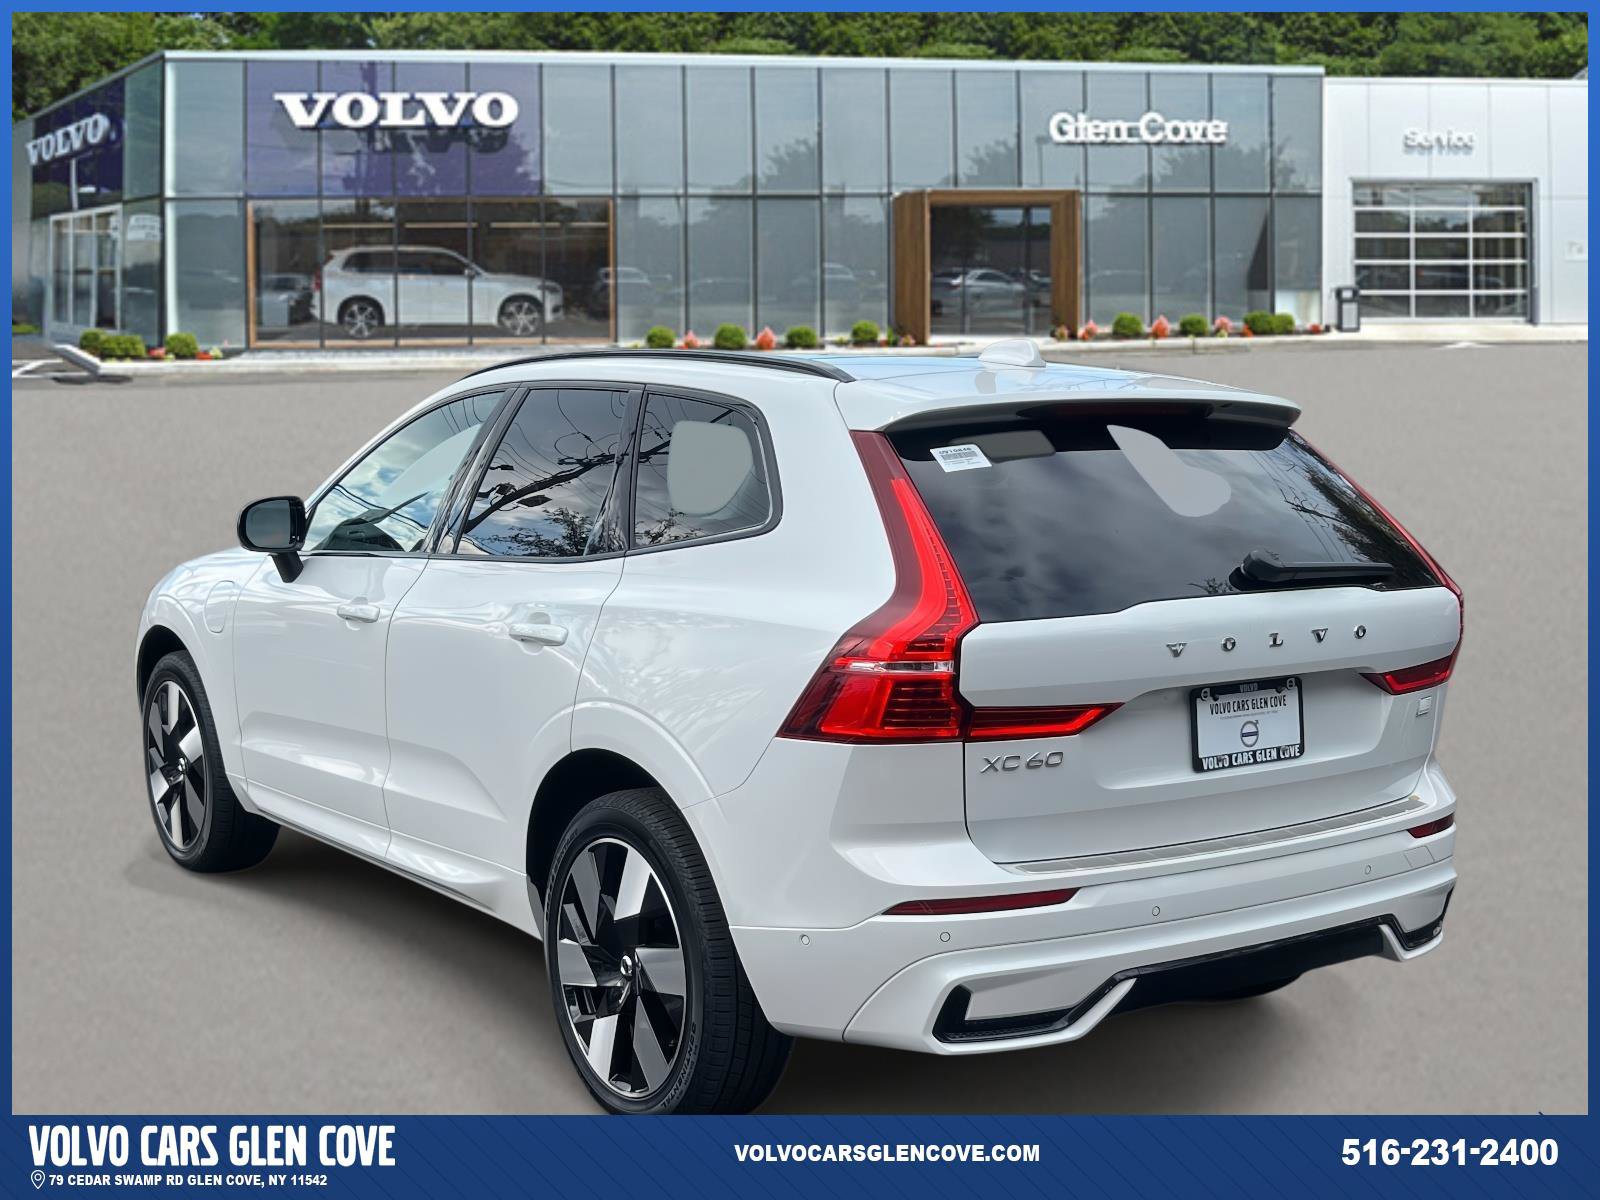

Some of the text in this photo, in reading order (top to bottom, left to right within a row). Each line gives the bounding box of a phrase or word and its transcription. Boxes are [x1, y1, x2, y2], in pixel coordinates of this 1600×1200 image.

[273, 92, 519, 128] VOLVO
[25, 112, 109, 165] VOLVO
[1049, 112, 1228, 143] Glen Cove
[1403, 127, 1475, 154] Service
[1166, 625, 1367, 658] VOLVO
[1240, 683, 1258, 693] VOLVO
[1209, 702, 1231, 716] VOLVO
[1232, 699, 1250, 713] CARS
[1251, 697, 1269, 710] GLEN
[1269, 695, 1287, 708] COVE
[1231, 751, 1254, 766] CARS
[1255, 747, 1277, 761] GLEN
[1279, 744, 1300, 759] COVE
